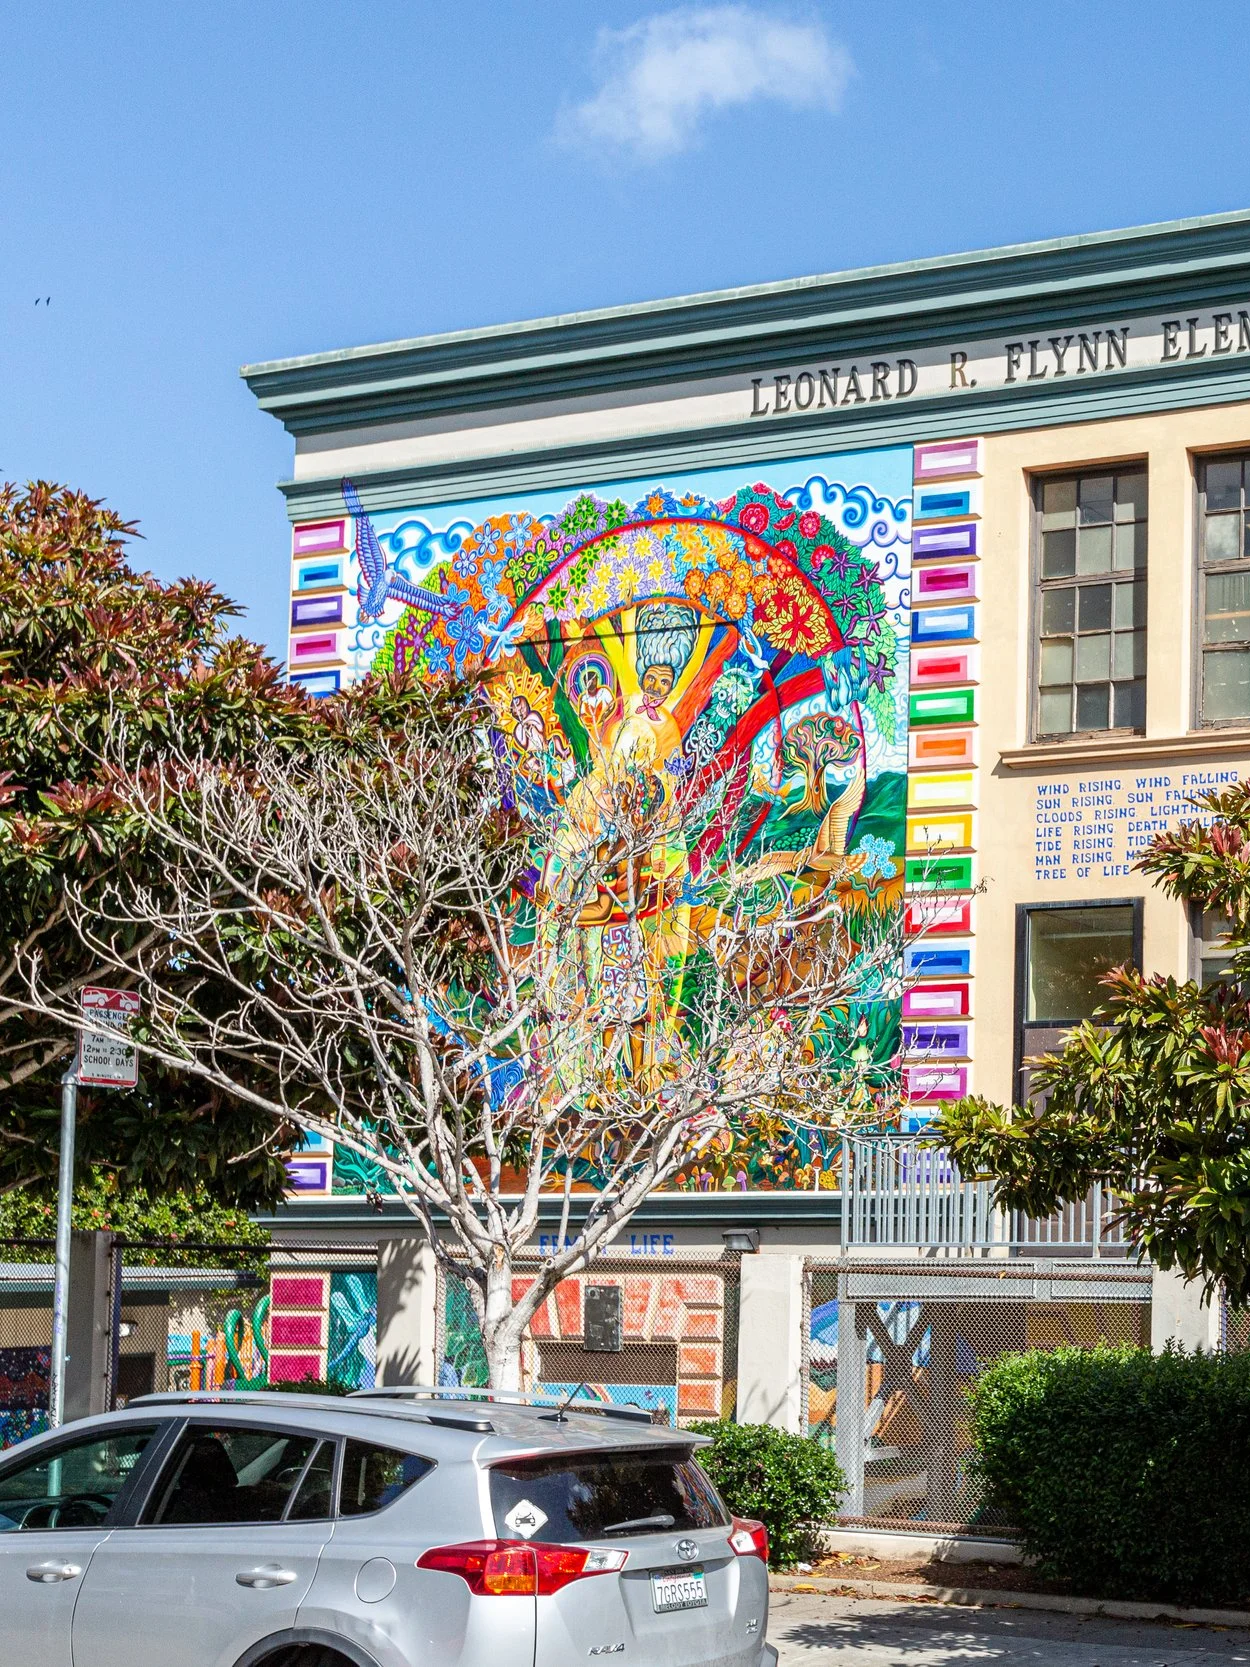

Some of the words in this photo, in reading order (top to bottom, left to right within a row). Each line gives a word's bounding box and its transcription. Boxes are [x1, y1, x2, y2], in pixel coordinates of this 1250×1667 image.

[750, 358, 918, 417] LEONARD
[949, 350, 977, 390] R.
[1004, 326, 1130, 384] FLYNN
[1037, 784, 1070, 796] WIND
[1135, 777, 1171, 789] WIND
[1182, 771, 1238, 785] FALLING
[1036, 798, 1061, 810] SUN
[1127, 792, 1153, 804] SUN
[1036, 811, 1082, 824] CLOUDS
[1036, 827, 1062, 838] LIFE
[1128, 820, 1168, 832] DEATH
[1035, 840, 1062, 852] TIDE
[1127, 834, 1153, 847] TIDE
[1035, 855, 1061, 867] MAN
[1035, 868, 1067, 880] TREE
[1076, 866, 1091, 878] OF
[1103, 865, 1130, 877] LIFE
[115, 1057, 134, 1068] DAYS
[630, 1234, 675, 1255] LIFE
[656, 1580, 704, 1605] 7GRS555
